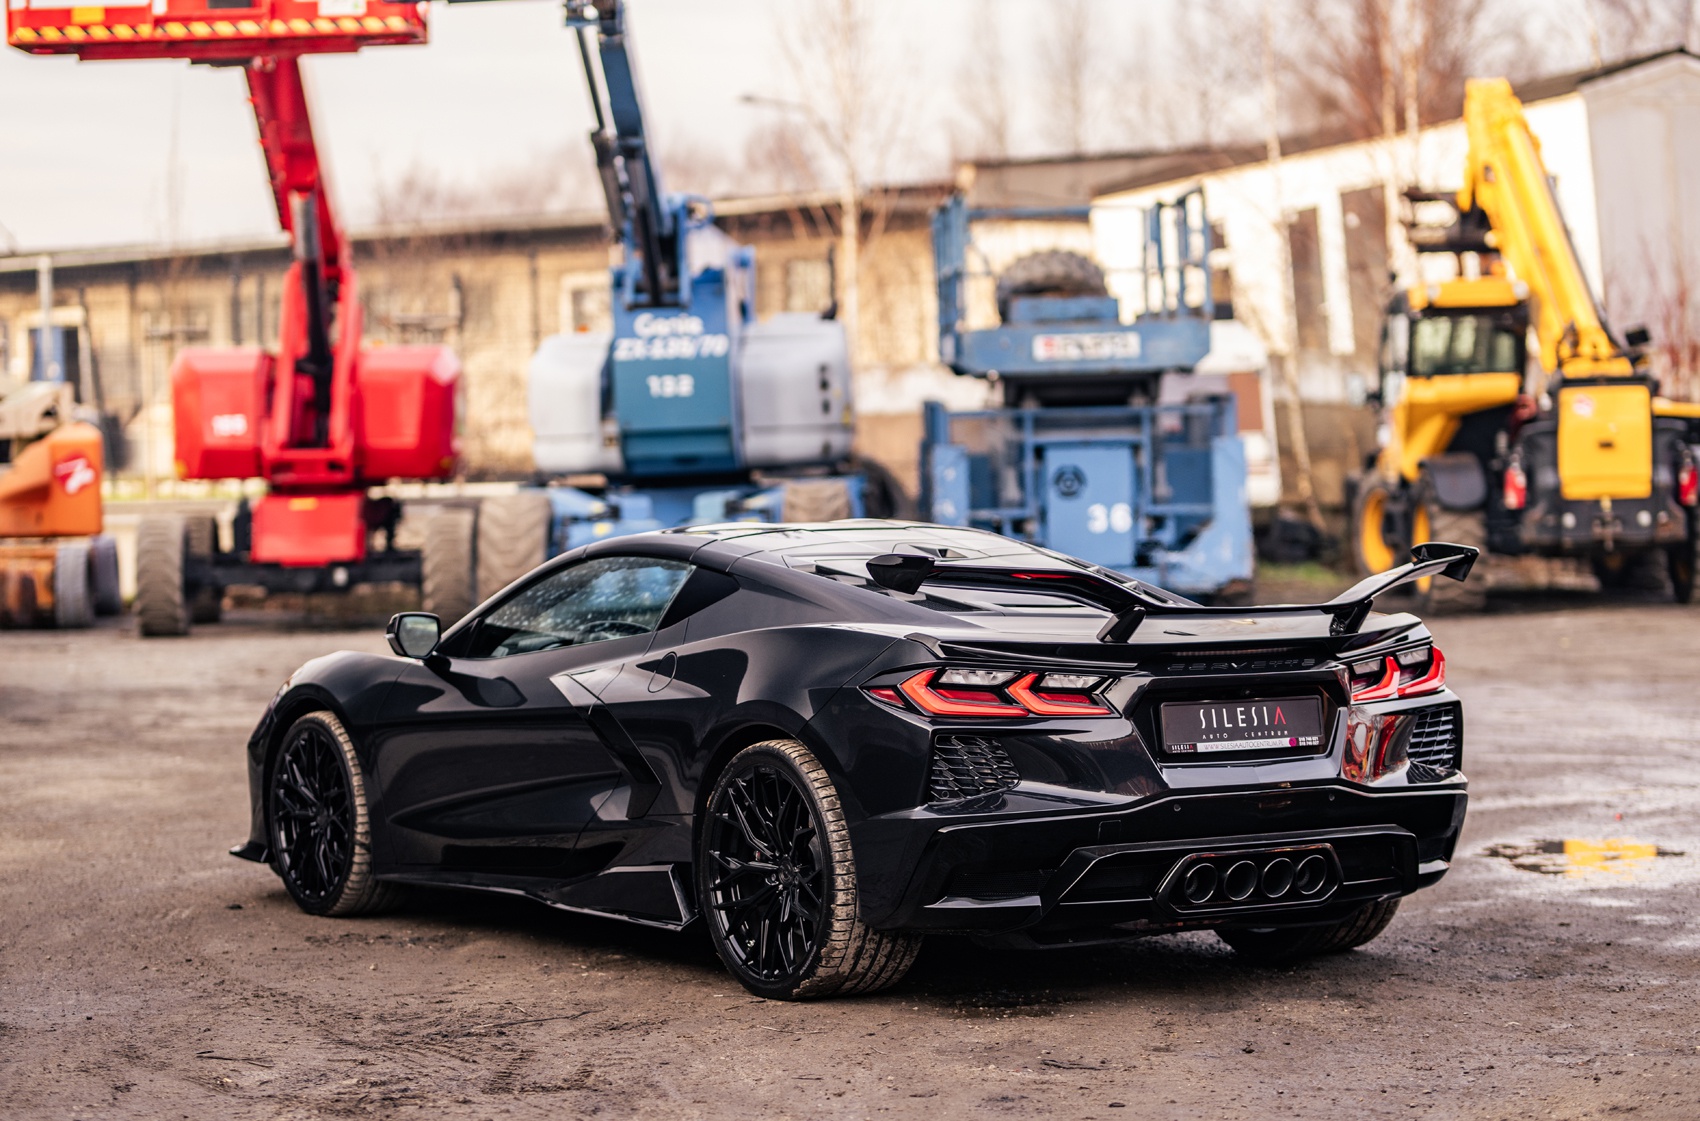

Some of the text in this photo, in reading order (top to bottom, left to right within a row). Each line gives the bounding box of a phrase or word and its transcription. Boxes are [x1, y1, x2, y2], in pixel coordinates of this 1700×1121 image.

[1087, 502, 1132, 534] 36
[1200, 706, 1287, 729] SILESIA
[1202, 730, 1289, 740] AUTO CENTRUM
